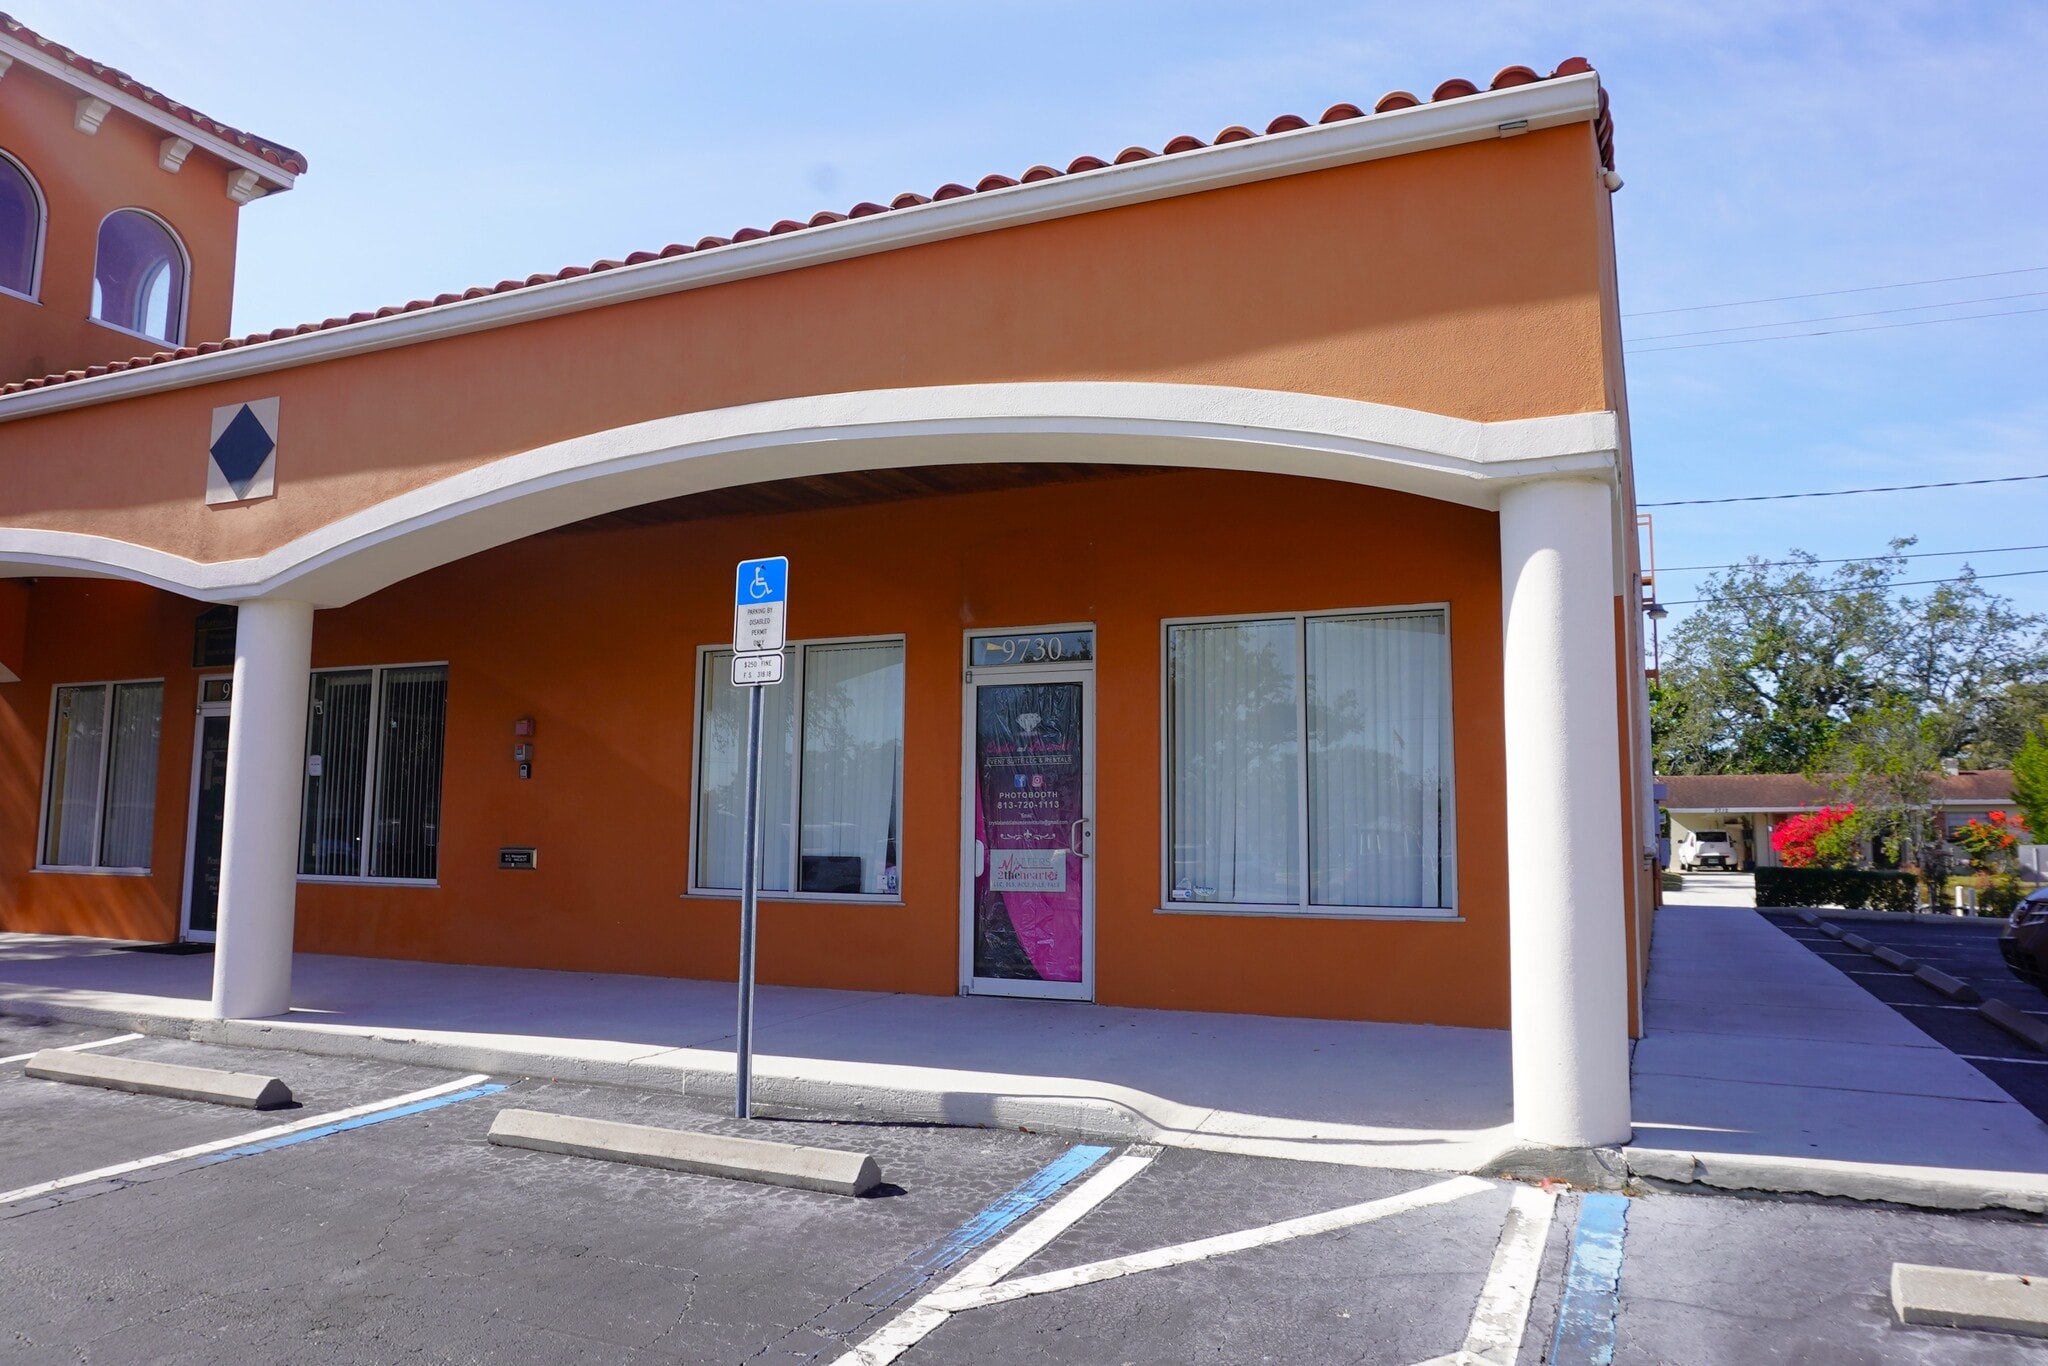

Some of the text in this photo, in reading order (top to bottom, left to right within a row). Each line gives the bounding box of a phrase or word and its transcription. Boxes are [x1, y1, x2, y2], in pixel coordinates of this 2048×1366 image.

[749, 618, 771, 626] DISABLED
[1002, 636, 1062, 663] 9730
[999, 791, 1058, 799] PHOTOBOOTH
[997, 800, 1060, 809] 813-720-1113
